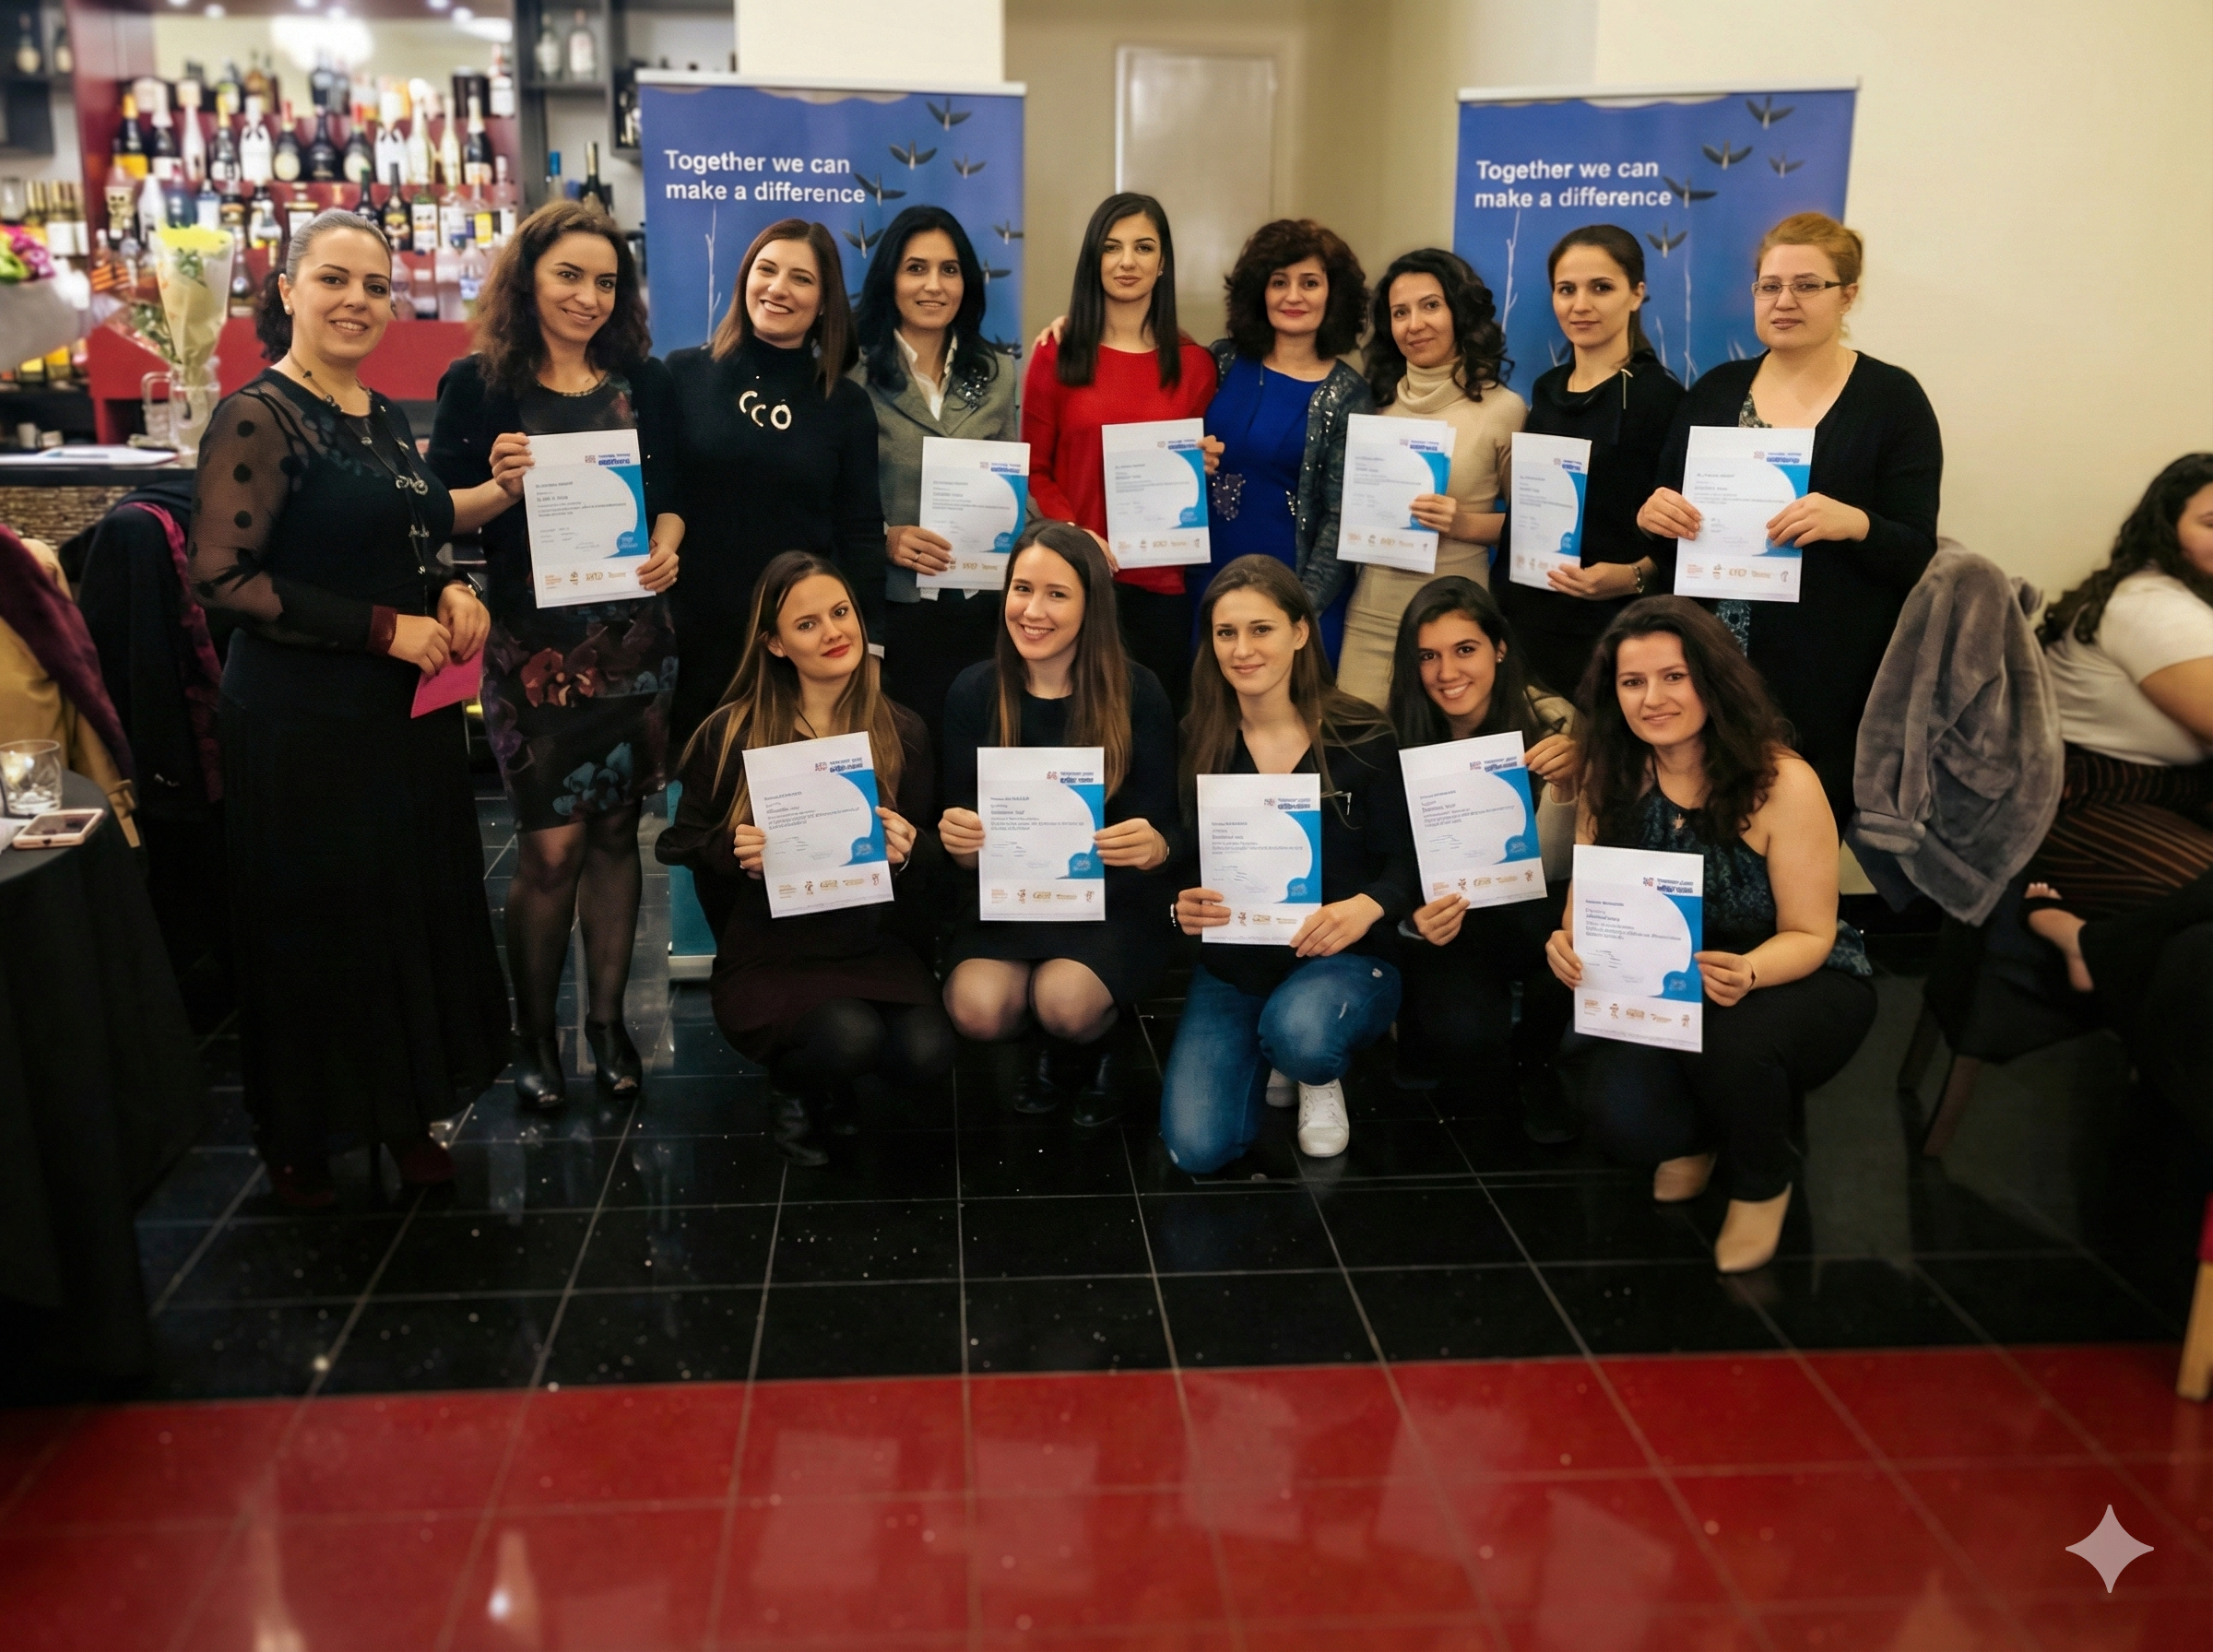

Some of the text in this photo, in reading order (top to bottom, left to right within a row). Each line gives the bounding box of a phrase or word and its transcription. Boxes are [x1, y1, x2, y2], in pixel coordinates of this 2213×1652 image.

[664, 149, 850, 174] Together we can
[1476, 159, 1659, 183] Together we can
[666, 180, 866, 204] make a difference
[1474, 186, 1672, 208] make a difference
